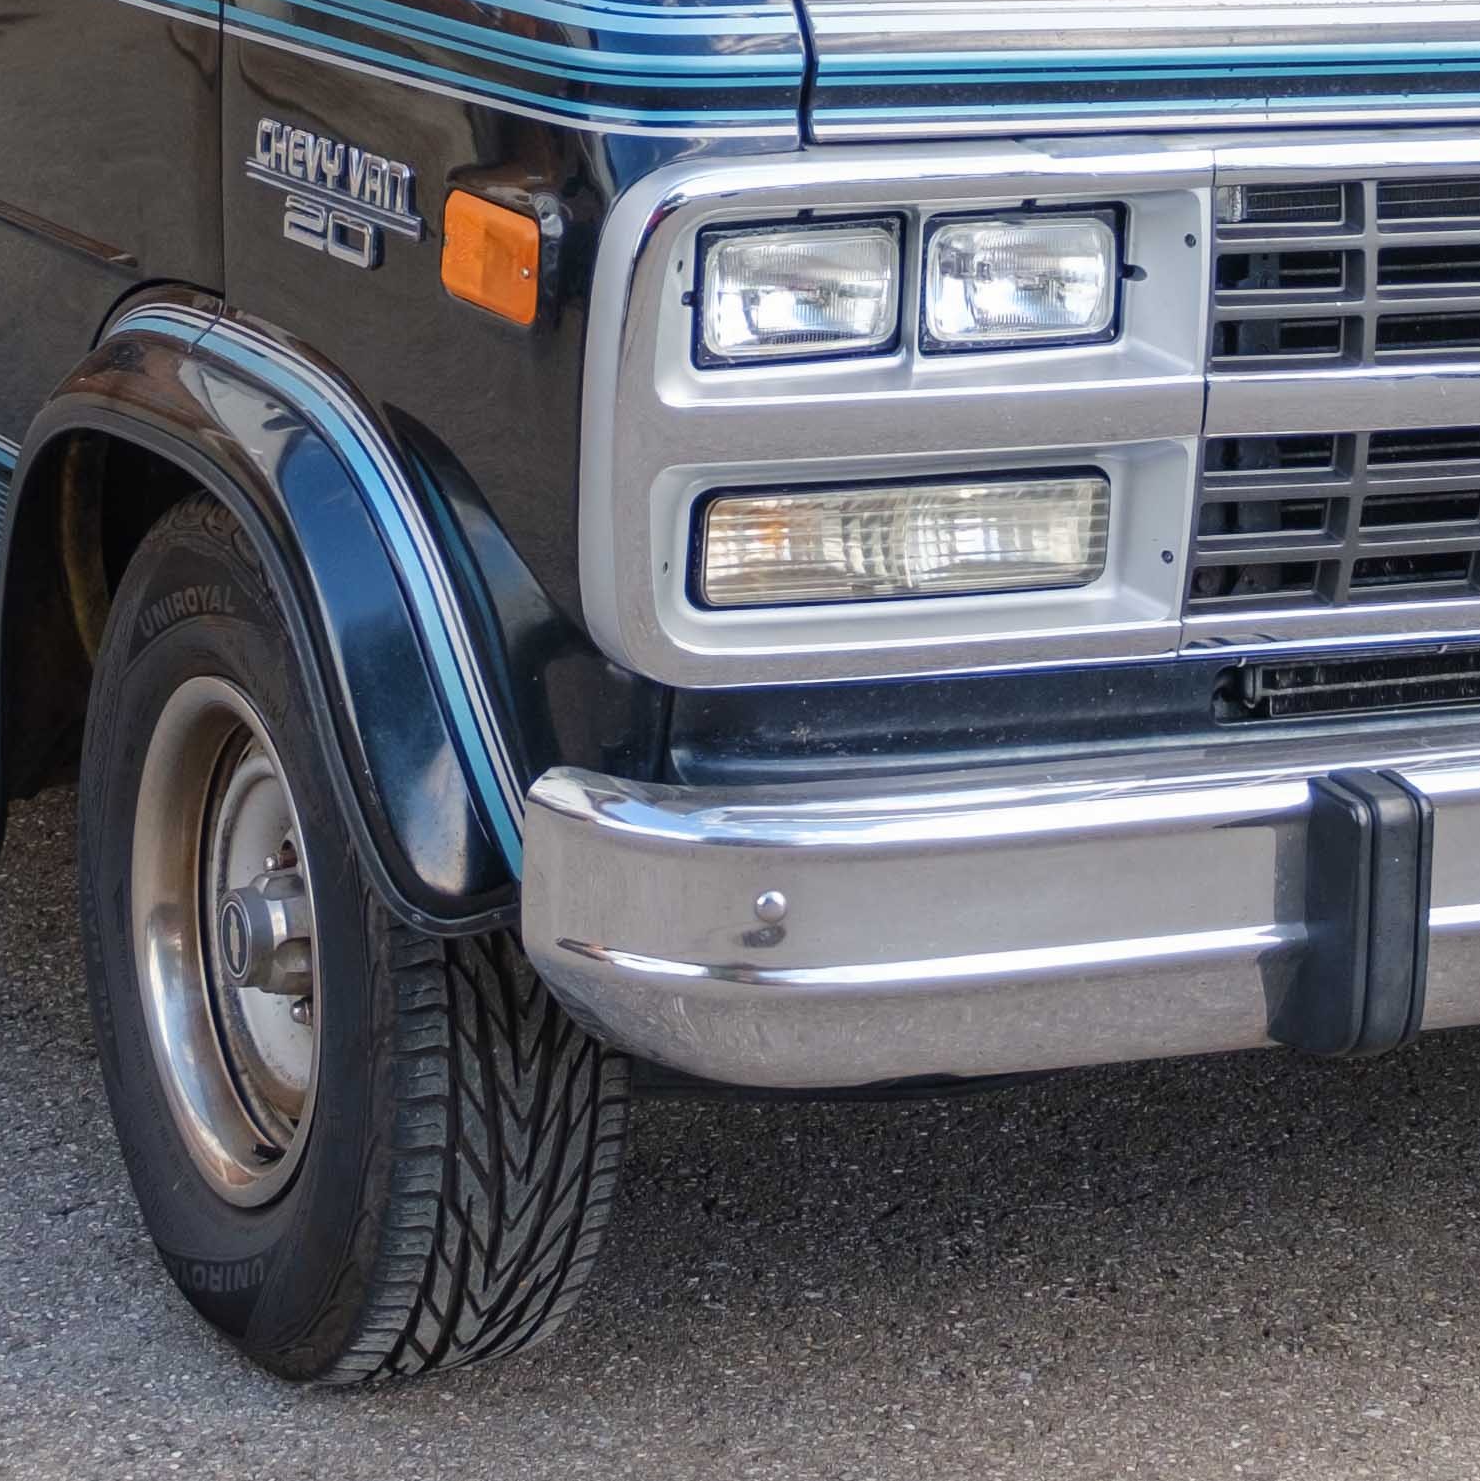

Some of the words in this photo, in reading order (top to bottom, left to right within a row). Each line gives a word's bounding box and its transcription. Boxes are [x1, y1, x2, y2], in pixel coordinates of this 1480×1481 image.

[255, 118, 346, 189] CHEVY
[348, 146, 417, 215] VAN
[283, 194, 376, 269] 20
[139, 584, 238, 638] UNIROYAL
